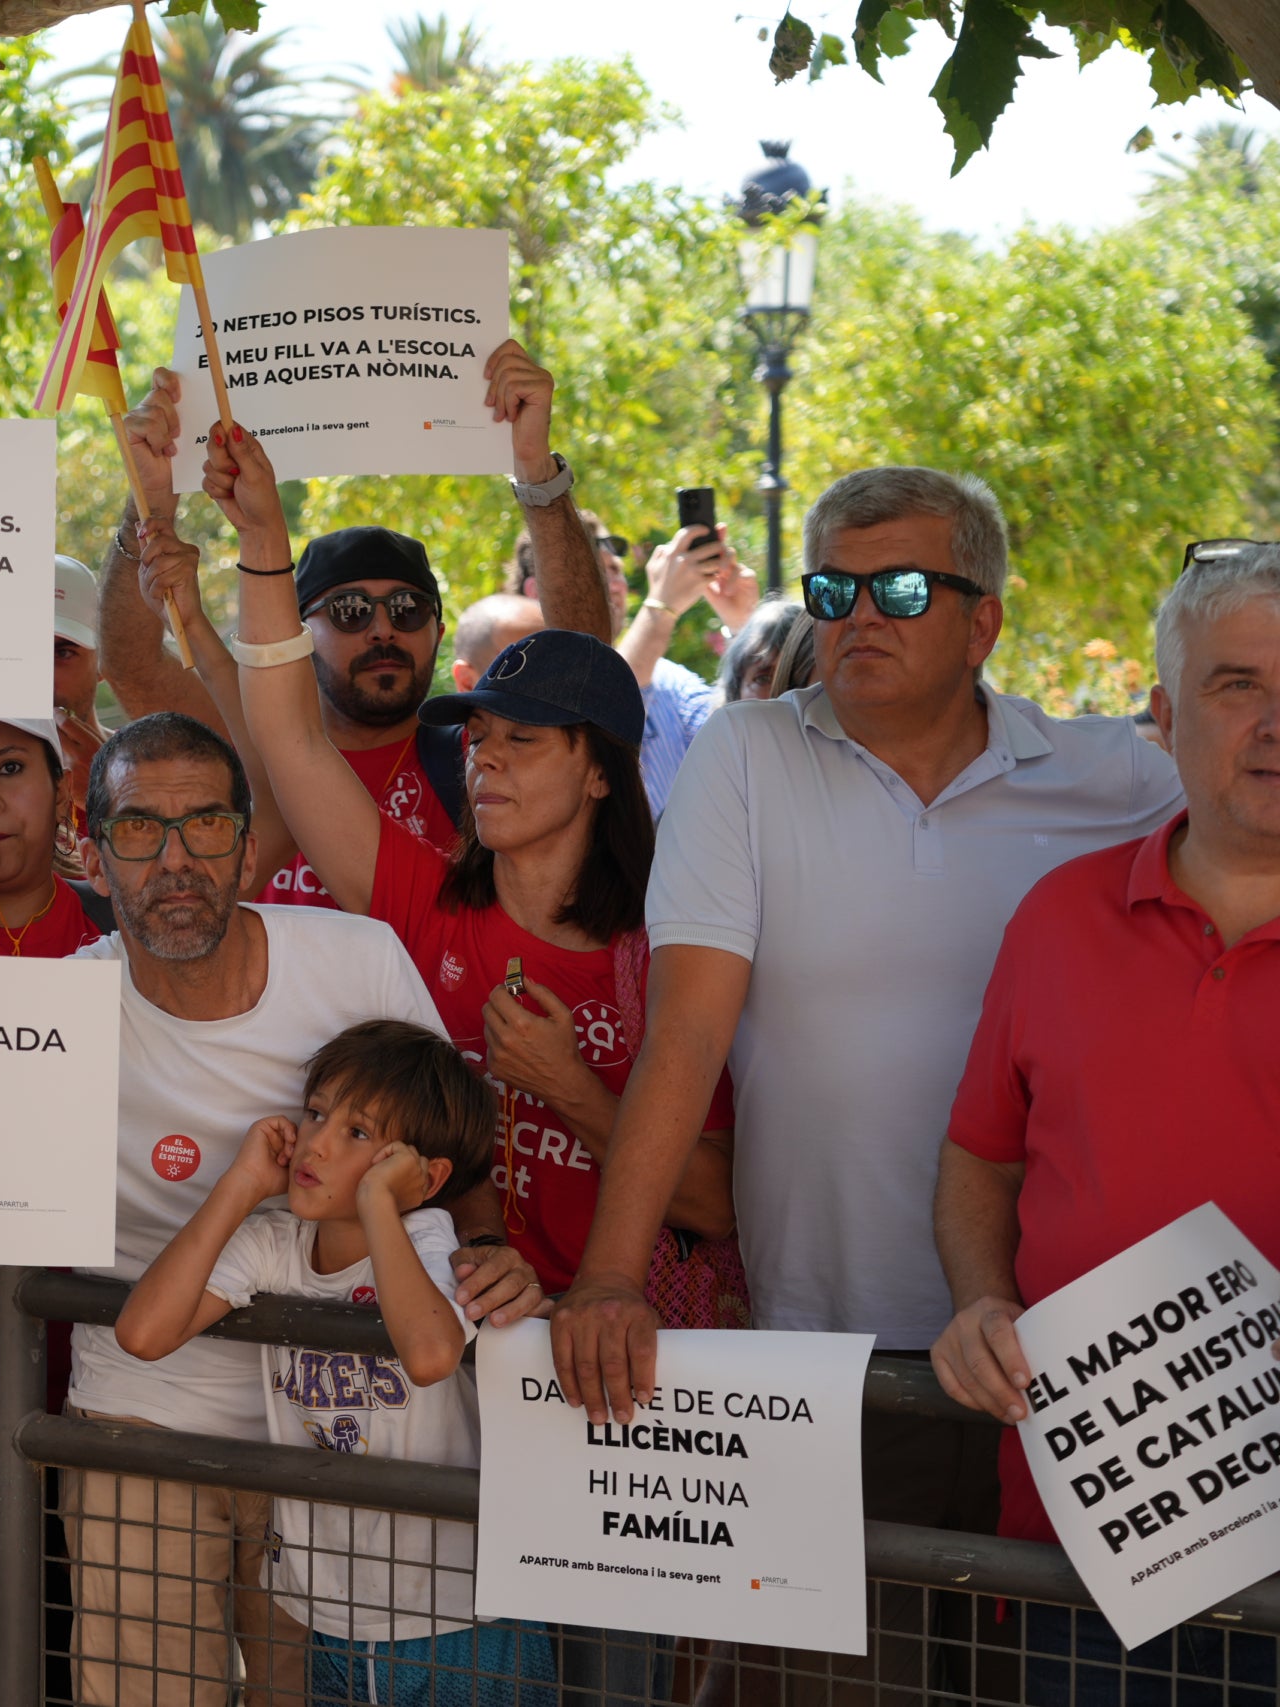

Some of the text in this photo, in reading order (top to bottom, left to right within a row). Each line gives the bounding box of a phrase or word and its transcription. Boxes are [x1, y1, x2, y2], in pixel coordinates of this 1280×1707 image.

[223, 303, 481, 333] NETEJO PISOS TURÍSTICS.
[226, 340, 475, 365] MEU FILL VA A L'ESCOLA
[224, 358, 458, 389] MB AQUESTA NÒMINA.
[260, 426, 304, 436] Barcelona
[306, 423, 309, 431] i
[312, 423, 320, 431] la
[346, 421, 369, 430] gent
[160, 1144, 195, 1156] TURISME
[167, 1154, 177, 1162] DE
[177, 1155, 193, 1163] TOTS
[1024, 1259, 1258, 1414] EL MAJOR ERO
[674, 1388, 813, 1423] DE CADA
[1044, 1410, 1105, 1462] DE
[1103, 1379, 1168, 1427] LA
[587, 1419, 748, 1459] LLICÈNCIA
[1070, 1367, 1280, 1509] DE CATALU
[590, 1469, 749, 1508] HI HA UNA
[603, 1510, 734, 1547] FAMÍLIA
[1098, 1491, 1189, 1554] PER
[1131, 1499, 1278, 1586] APARTUR amb Barcelona i la
[519, 1555, 721, 1584] APARTUR amb Barcelona i la seva gent
[761, 1576, 788, 1585] APARTUR
